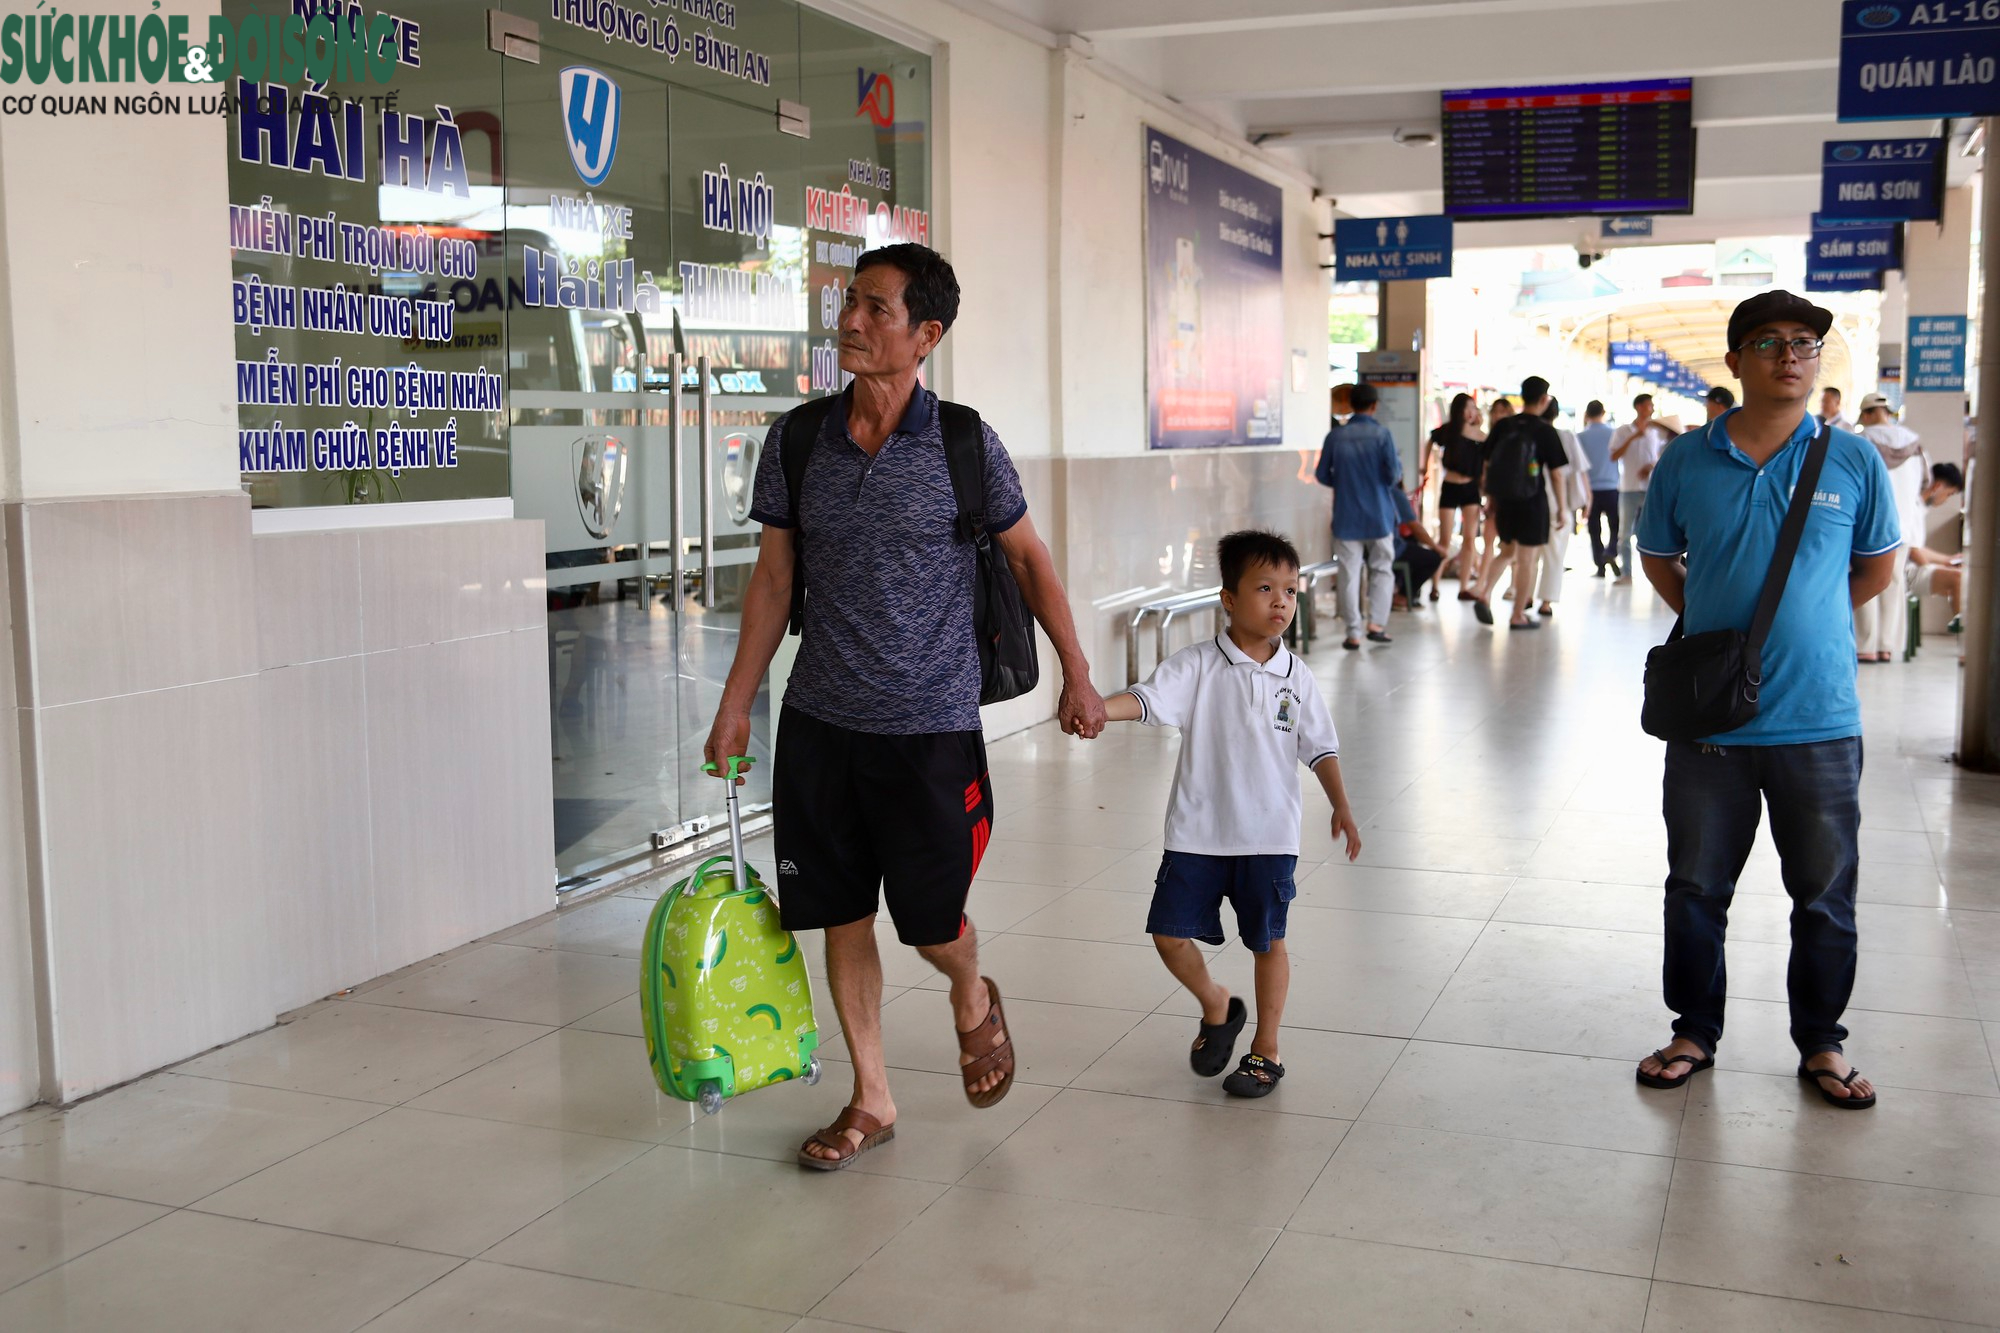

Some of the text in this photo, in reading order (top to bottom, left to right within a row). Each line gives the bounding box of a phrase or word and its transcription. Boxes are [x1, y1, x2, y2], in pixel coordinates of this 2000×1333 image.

[1908, 0, 2000, 25] A1-16
[651, 14, 680, 64] LỘ
[694, 26, 740, 77] BÌNH
[742, 50, 770, 86] AN
[1860, 55, 1935, 92] QUÁN
[237, 67, 470, 198] HẢI HÀ
[1867, 143, 1928, 160] A1-17
[848, 157, 891, 190] NHÀ XE
[1838, 179, 1920, 201] NGA SƠN
[550, 192, 634, 240] NHÀ XE
[703, 162, 774, 250] HÀ NỘI
[805, 183, 929, 247] KHIÊM OANH
[229, 195, 291, 256] MIỄN
[298, 212, 336, 262] PHÍ
[340, 221, 396, 276] TRỌN
[400, 224, 434, 275] ĐỜI
[439, 237, 478, 280] CHO
[232, 274, 297, 335] BỆNH
[302, 283, 363, 334] NHÂN
[369, 294, 412, 338] UNG
[415, 299, 455, 342] THƯ
[523, 244, 661, 314] Hải Hà
[679, 261, 752, 323] THANH
[236, 347, 502, 417] MIỄN PHÍ CHO BỆNH NHÂN
[813, 339, 838, 397] NỘI
[238, 417, 458, 477] KHÁM CHỮA BỆNH VỀ
[780, 859, 798, 870] EA
